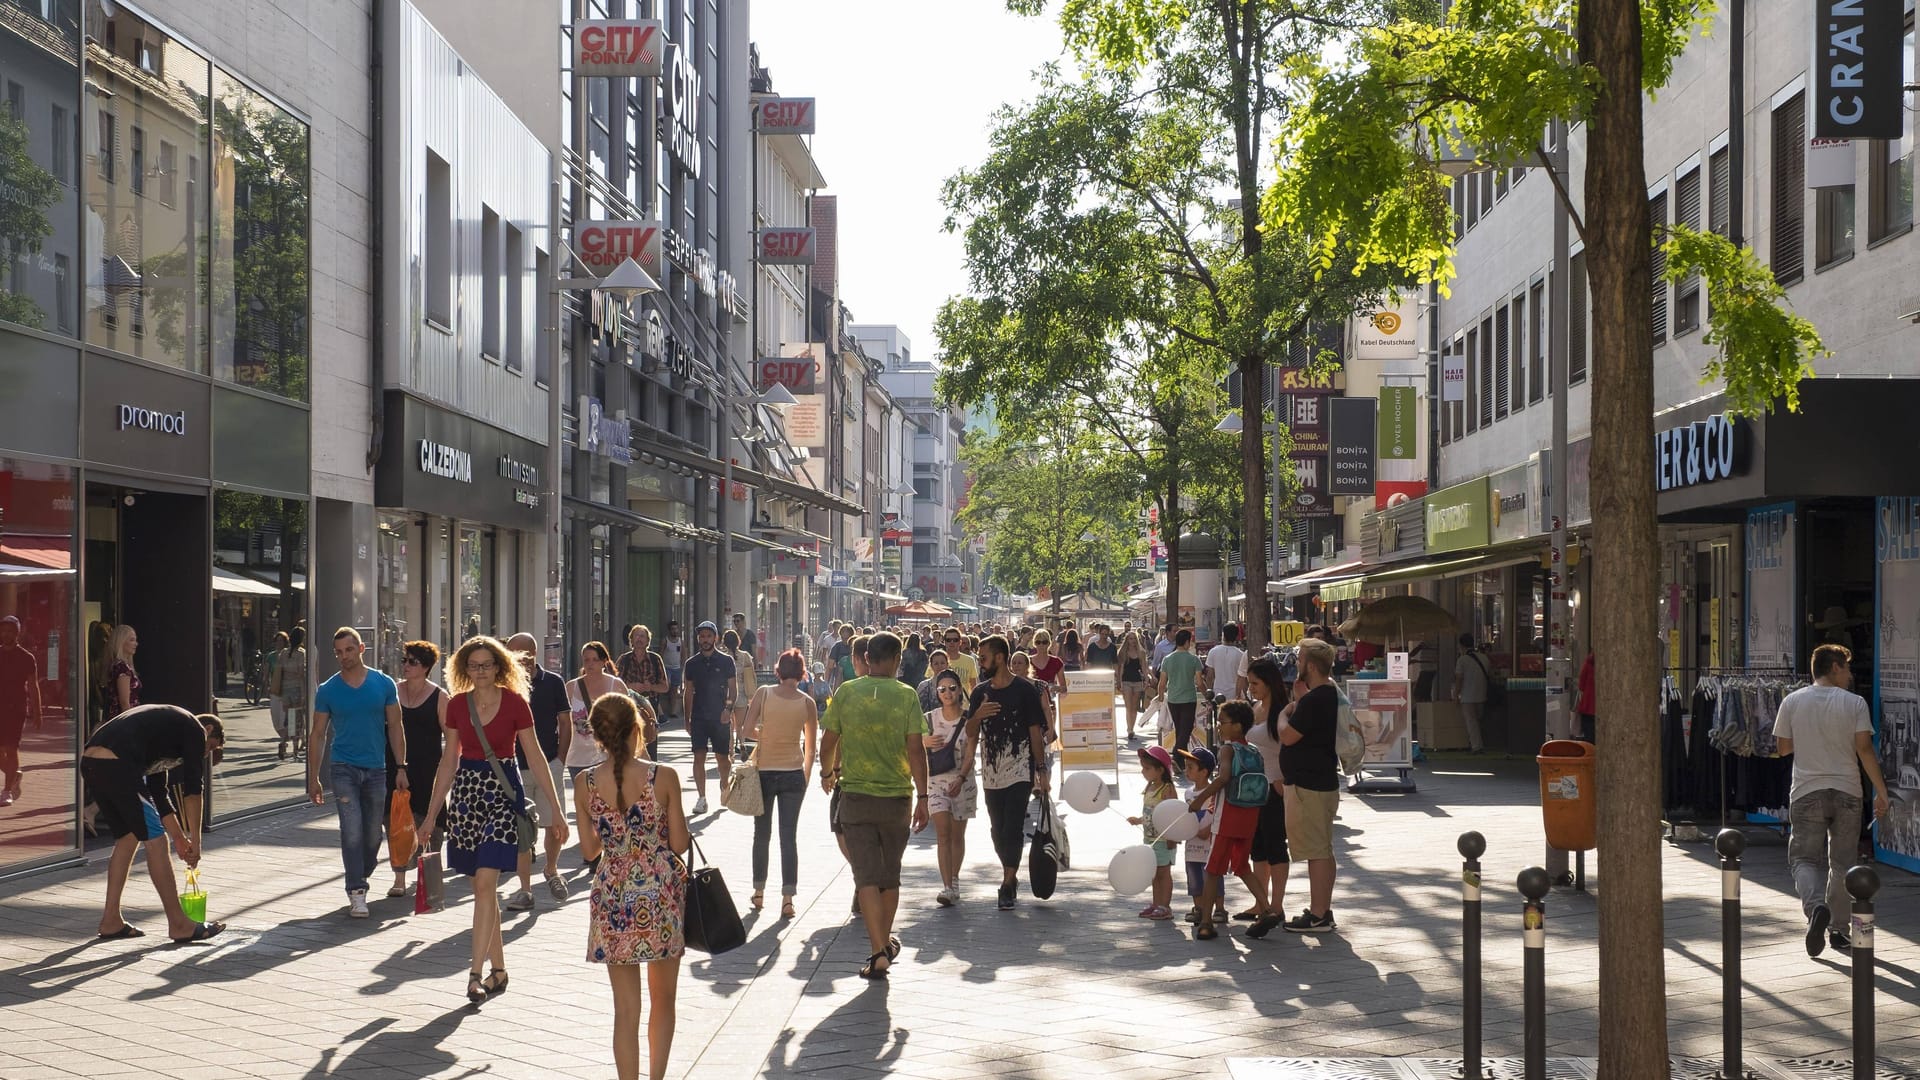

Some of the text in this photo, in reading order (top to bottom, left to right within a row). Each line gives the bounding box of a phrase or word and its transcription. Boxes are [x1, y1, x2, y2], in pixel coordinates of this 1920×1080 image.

[581, 26, 656, 64] CITY
[581, 51, 629, 65] POINT
[672, 45, 700, 150] CITY
[763, 101, 811, 127] CITY
[763, 118, 794, 127] POINT
[581, 227, 656, 261] CITY
[763, 232, 811, 256] CITY
[763, 248, 795, 257] POINT
[762, 362, 811, 386] CITY
[1283, 369, 1332, 389] ASIA
[121, 404, 185, 435] promod
[1292, 443, 1329, 451] STAURAN
[1687, 421, 1701, 485] &
[1704, 411, 1733, 480] CO
[421, 439, 471, 483] CALZEDONIA
[1275, 624, 1293, 644] 10
